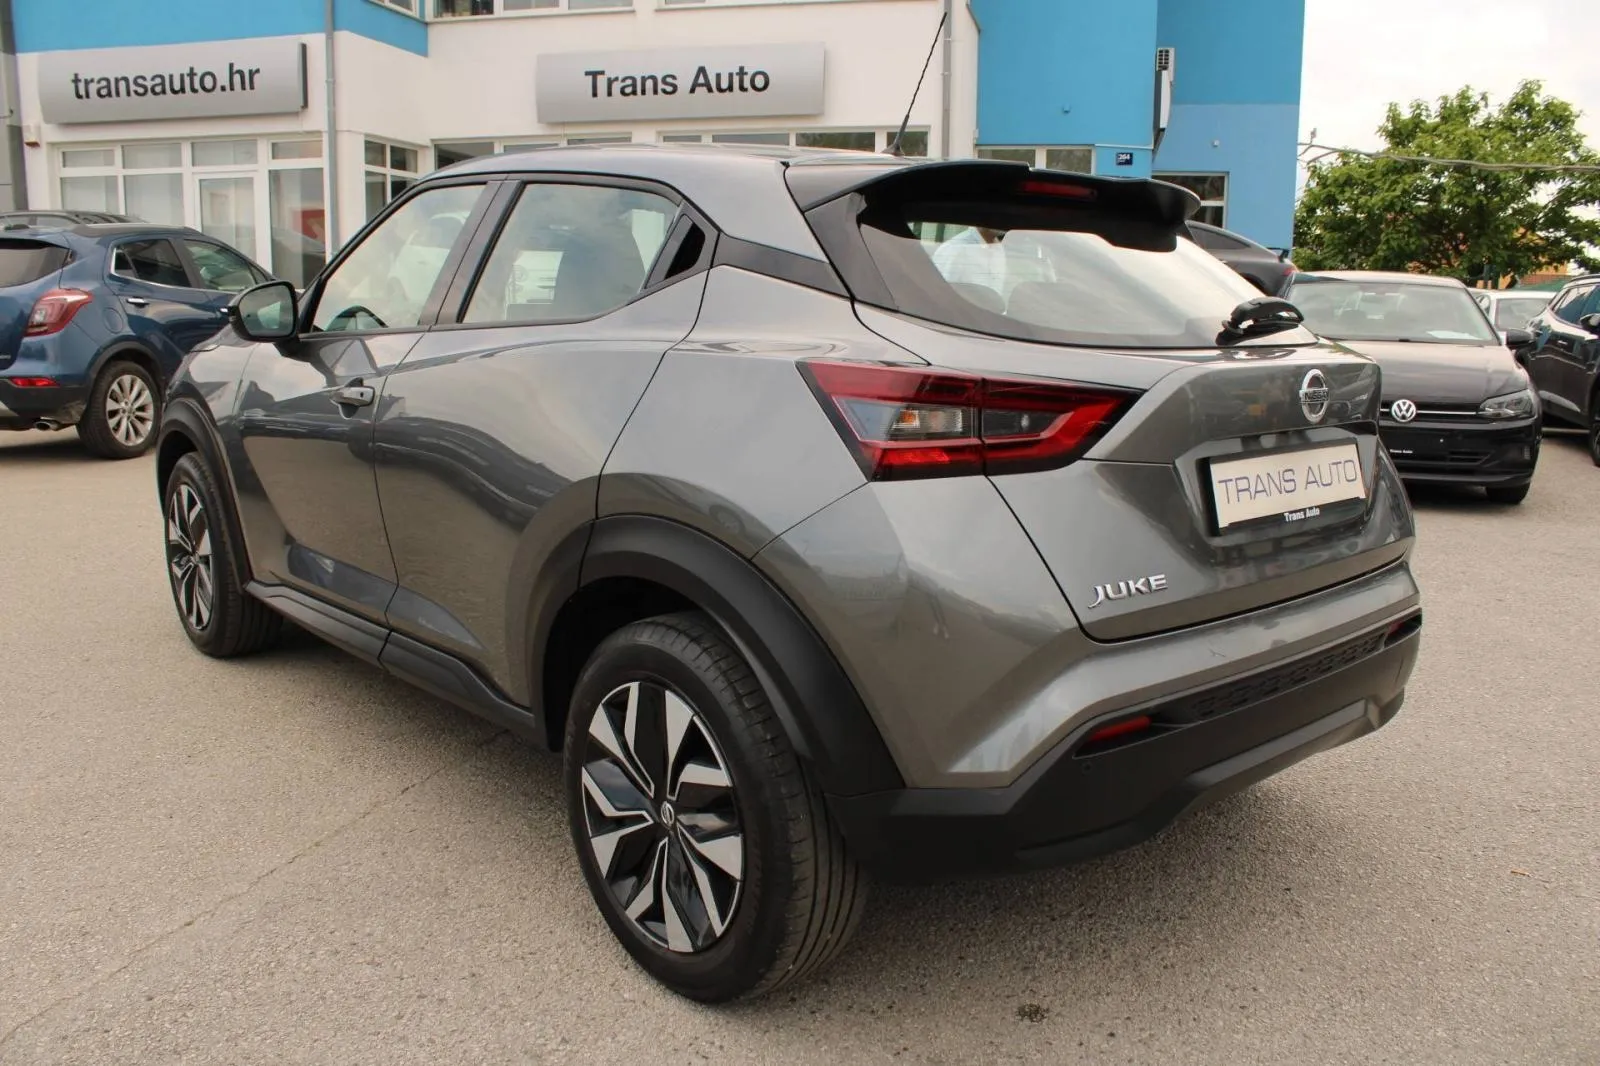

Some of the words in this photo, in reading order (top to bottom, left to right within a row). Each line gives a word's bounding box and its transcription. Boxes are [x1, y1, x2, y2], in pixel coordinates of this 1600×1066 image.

[71, 62, 260, 100] transauto.hr
[584, 70, 678, 98] Trans
[689, 65, 770, 94] Auto
[1218, 468, 1297, 504] TRANS
[1304, 459, 1357, 490] AUTO
[1284, 511, 1304, 522] Trans
[1305, 506, 1320, 517] Auto
[1087, 574, 1168, 609] JUKE
